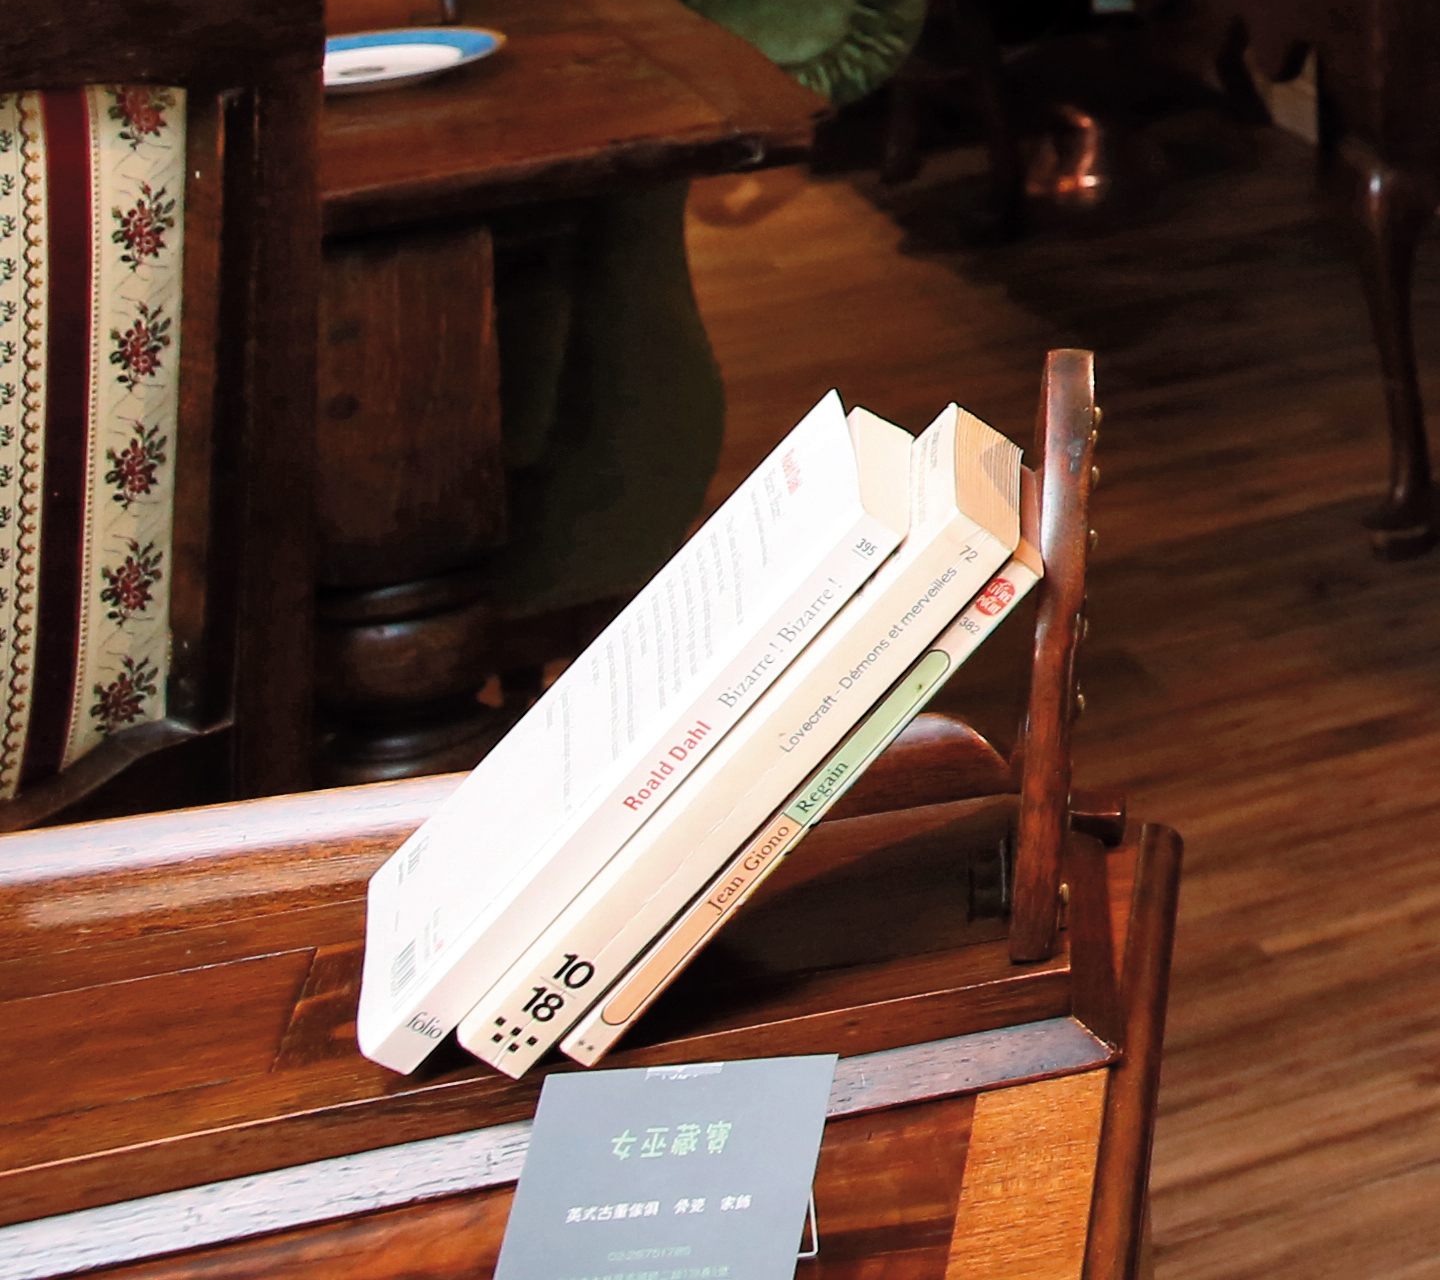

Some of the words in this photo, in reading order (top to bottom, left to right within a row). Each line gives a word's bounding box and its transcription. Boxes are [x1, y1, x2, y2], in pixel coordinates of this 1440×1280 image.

[855, 538, 878, 556] 395
[959, 545, 979, 563] 72
[987, 582, 1013, 604] LIVRE
[959, 617, 981, 635] 382
[779, 695, 838, 754] Lovecraft
[838, 638, 890, 691] Démons
[888, 624, 904, 640] et
[901, 567, 957, 627] merveilles
[623, 760, 674, 811] Roald
[669, 720, 712, 761] Dahl
[718, 652, 775, 709] Bizarre
[776, 587, 834, 644] Bizarre
[706, 876, 745, 915] Jean
[743, 825, 790, 871] Giono
[795, 761, 849, 814] Regain
[553, 952, 596, 989] 10
[521, 985, 565, 1023] 18
[404, 1010, 443, 1040] folio
